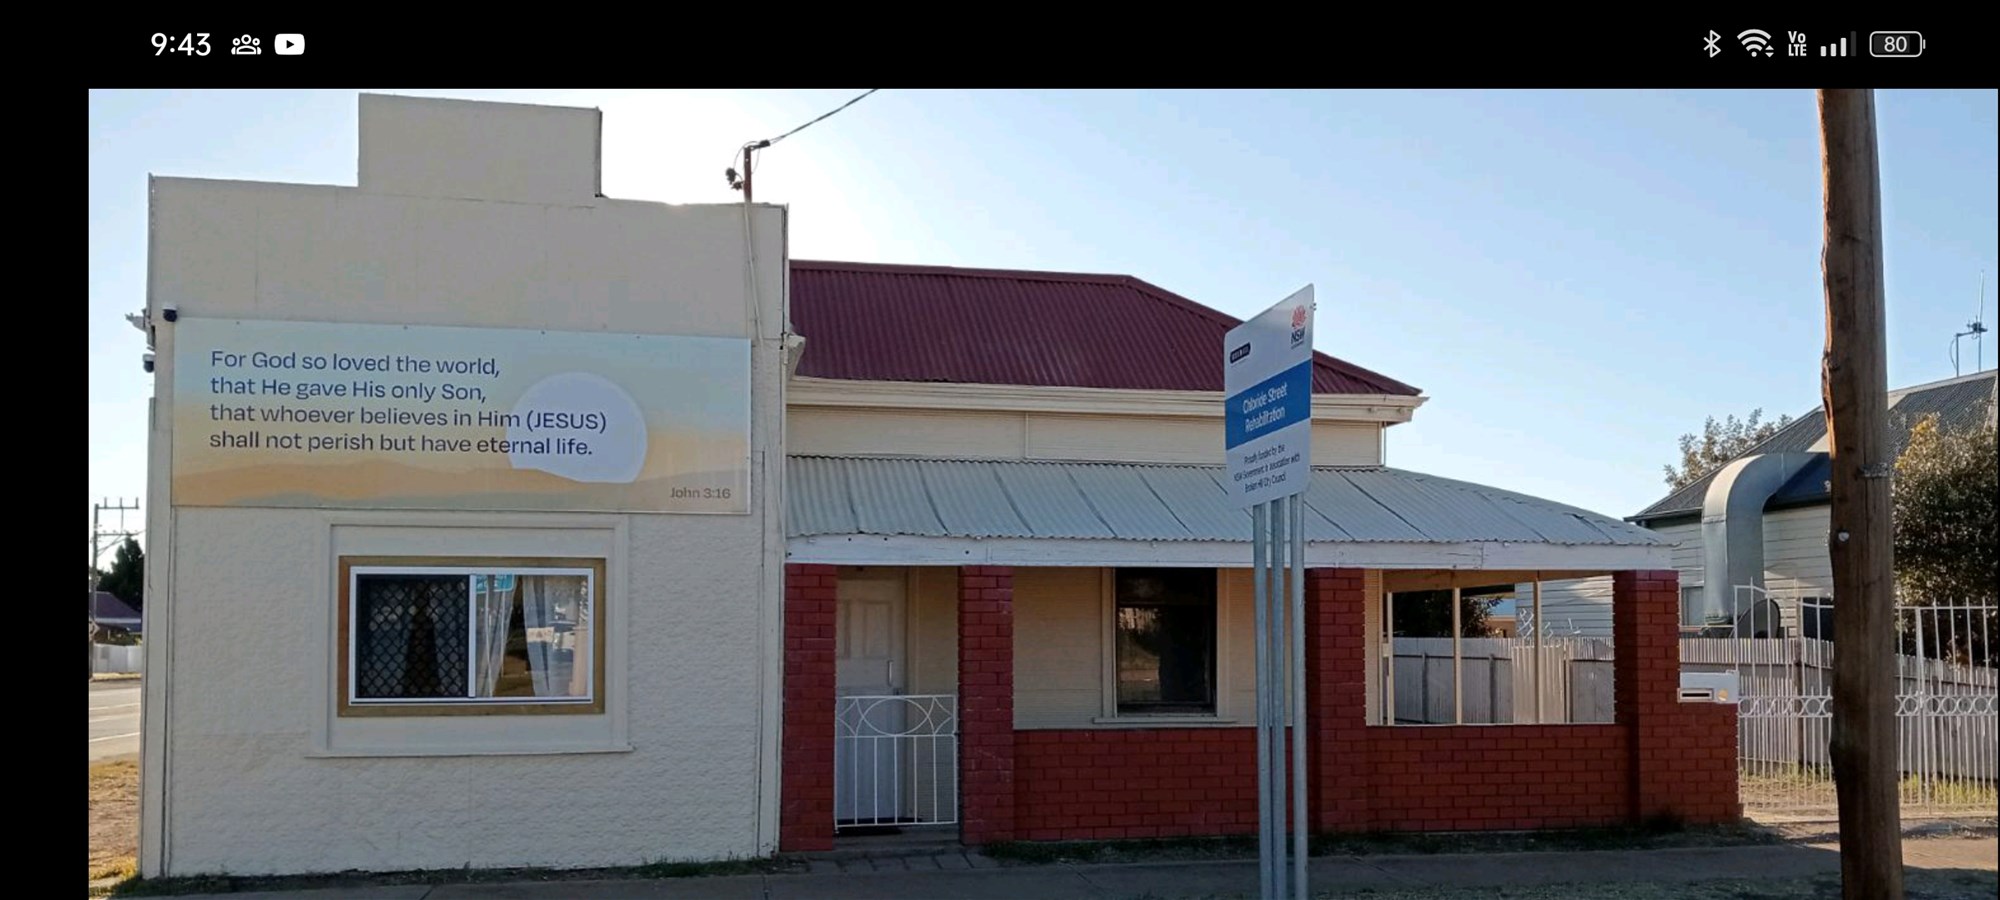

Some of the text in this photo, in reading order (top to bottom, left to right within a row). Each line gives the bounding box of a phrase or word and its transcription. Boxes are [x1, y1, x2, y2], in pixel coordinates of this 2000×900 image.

[1291, 327, 1305, 344] NSW
[211, 350, 500, 379] For God so loved the world,
[210, 376, 487, 404] that He gave His only Son,
[1243, 382, 1288, 414] Chloride Street
[209, 403, 607, 435] that whoever believes in Him (JESUS)
[1245, 406, 1286, 433] Rehabilitation
[209, 430, 593, 456] shall not perish but have eternal life.
[670, 487, 732, 499] John 3:16
